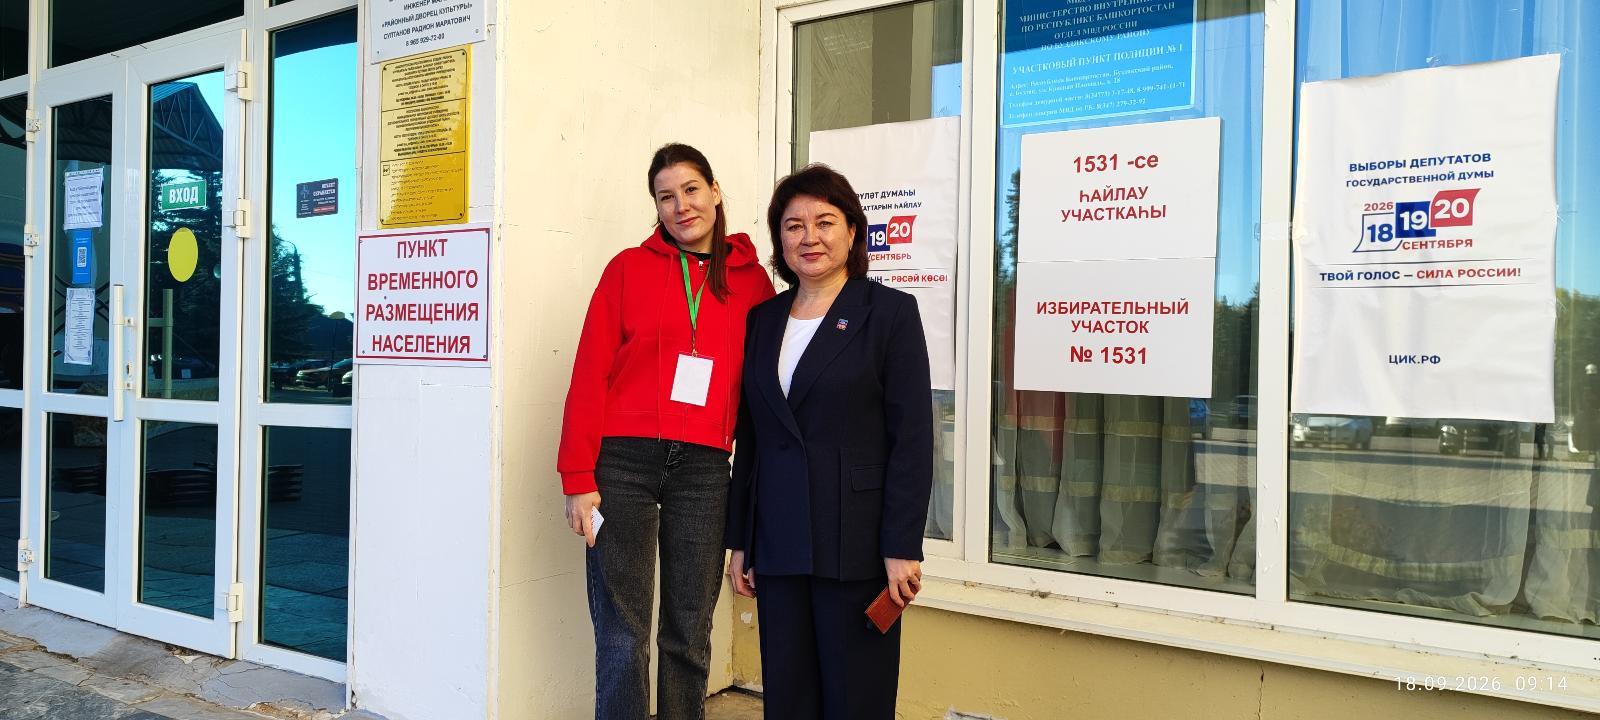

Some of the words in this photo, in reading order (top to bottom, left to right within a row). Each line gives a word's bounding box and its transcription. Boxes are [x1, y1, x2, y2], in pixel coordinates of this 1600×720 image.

[415, 10, 438, 21] ДВОРЕЦ
[1020, 6, 1091, 22] МИНИСТЕРСТВО
[1036, 14, 1095, 30] РЕСПУБЛИКЕ
[1097, 2, 1175, 20] БАШКОРТОСТАН
[412, 23, 434, 33] РАДИОН
[436, 15, 470, 28] МАРАТОВИЧ
[1054, 29, 1080, 39] ОТДЕЛ
[1082, 26, 1101, 35] МВД
[1102, 20, 1138, 31] РОССИИ
[1117, 28, 1151, 39] РАЙОНУ
[1012, 56, 1077, 74] УЧАСТКОВЫЙ
[1079, 53, 1111, 67] ПУНКТ
[1114, 45, 1164, 61] ПОЛИЦИИ
[1166, 44, 1176, 53] №
[1074, 153, 1118, 173] 1531
[1127, 154, 1159, 169] -се
[1349, 159, 1407, 172] ВЫБОРЫ
[1409, 153, 1492, 169] ДЕПУТАТОВ
[1346, 171, 1455, 187] ГОСУДАРСТВЕННОЙ
[1457, 170, 1494, 181] ДУМЫ
[169, 186, 198, 204] ВХОД
[1364, 201, 1394, 212] 2026
[1367, 223, 1393, 243] 18
[1399, 210, 1428, 231] 19
[1434, 197, 1470, 220] 20
[869, 230, 886, 247] 19
[889, 221, 911, 238] 20
[397, 238, 448, 258] ПУНКТ
[1402, 238, 1473, 250] СЕНТЯБРЯ
[870, 253, 912, 261] СЕНТЯБРЬ
[367, 269, 479, 291] ВРЕМЕННОГО
[1319, 269, 1354, 282] ТВОЙ
[1357, 270, 1400, 281] ГОЛОС
[1416, 269, 1454, 279] СИЛА
[1457, 267, 1521, 279] РОССИИ!
[365, 302, 479, 324] РАЗМЕЩЕНИЯ
[1036, 297, 1189, 315] ИЗБИРАТЕЛЬНЫЙ
[1071, 320, 1150, 334] УЧАСТОК
[372, 334, 471, 354] НАСЕЛЕНИЯ
[1070, 345, 1093, 363] №
[1100, 346, 1146, 364] 1531
[1388, 354, 1441, 365] ЦИК.РФ
